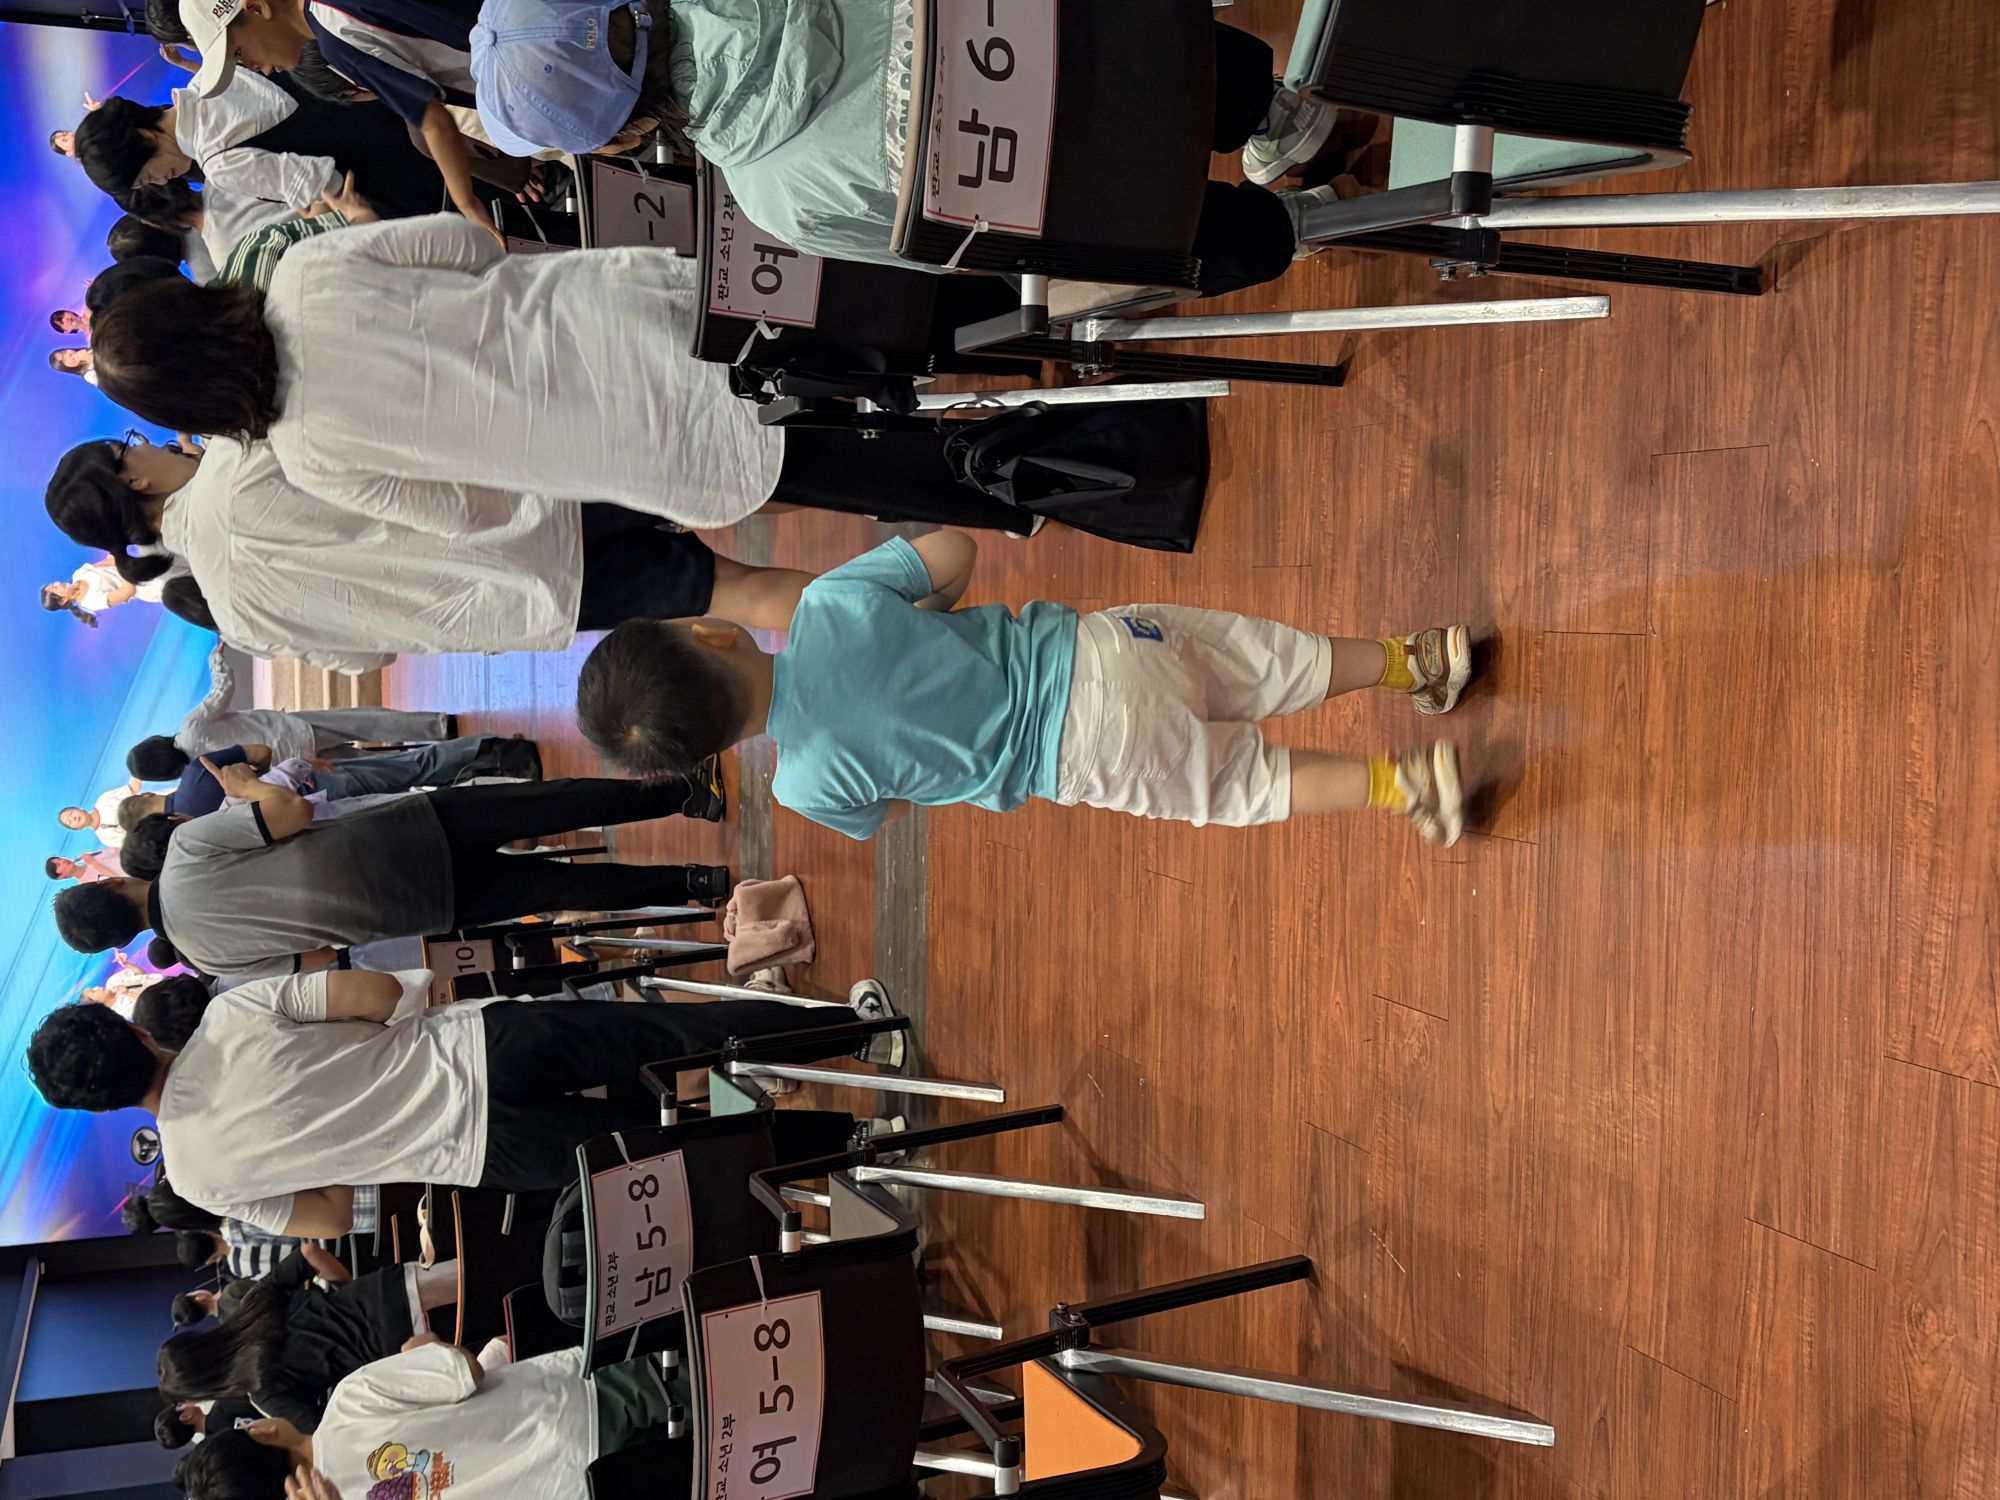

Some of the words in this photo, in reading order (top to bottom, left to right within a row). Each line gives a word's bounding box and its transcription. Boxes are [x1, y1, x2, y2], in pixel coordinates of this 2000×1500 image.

[586, 18, 596, 48] POLO
[935, 94, 944, 143] 소년
[958, 108, 1018, 188] 남
[931, 152, 940, 198] 판교
[722, 193, 736, 221] 2부
[720, 227, 734, 262] 소년
[717, 268, 730, 300] 판교
[751, 244, 798, 295] 여
[456, 947, 476, 973] 10
[628, 1174, 667, 1250] 5-8
[608, 1251, 619, 1271] 2부
[607, 1275, 618, 1298] 소년
[634, 1267, 671, 1307] 남
[604, 1302, 616, 1327] 판교
[754, 1318, 794, 1414] 5-8
[722, 1414, 735, 1439] 2부
[718, 1443, 732, 1473] 소년
[750, 1436, 796, 1484] 여
